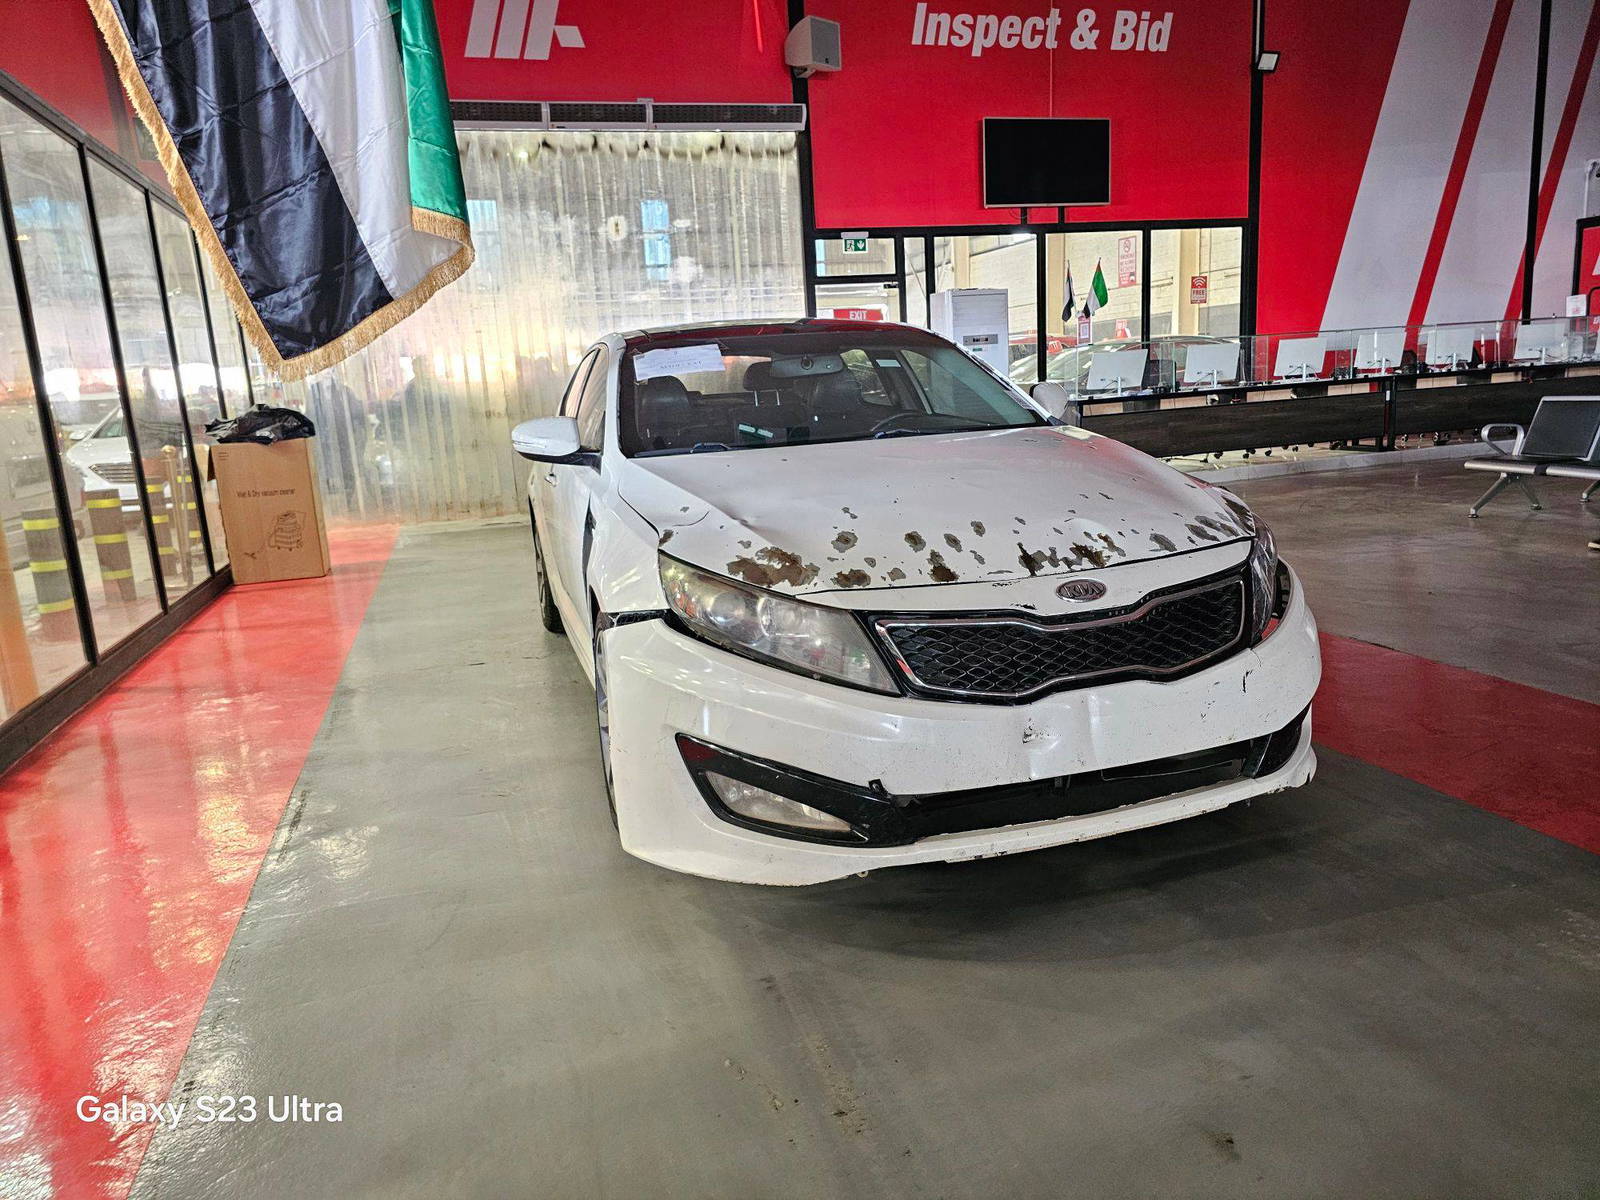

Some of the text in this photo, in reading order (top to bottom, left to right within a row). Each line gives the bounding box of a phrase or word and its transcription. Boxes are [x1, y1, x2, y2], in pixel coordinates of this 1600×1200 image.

[911, 2, 1174, 57] Inspect & Bid
[849, 311, 867, 320] EXIT
